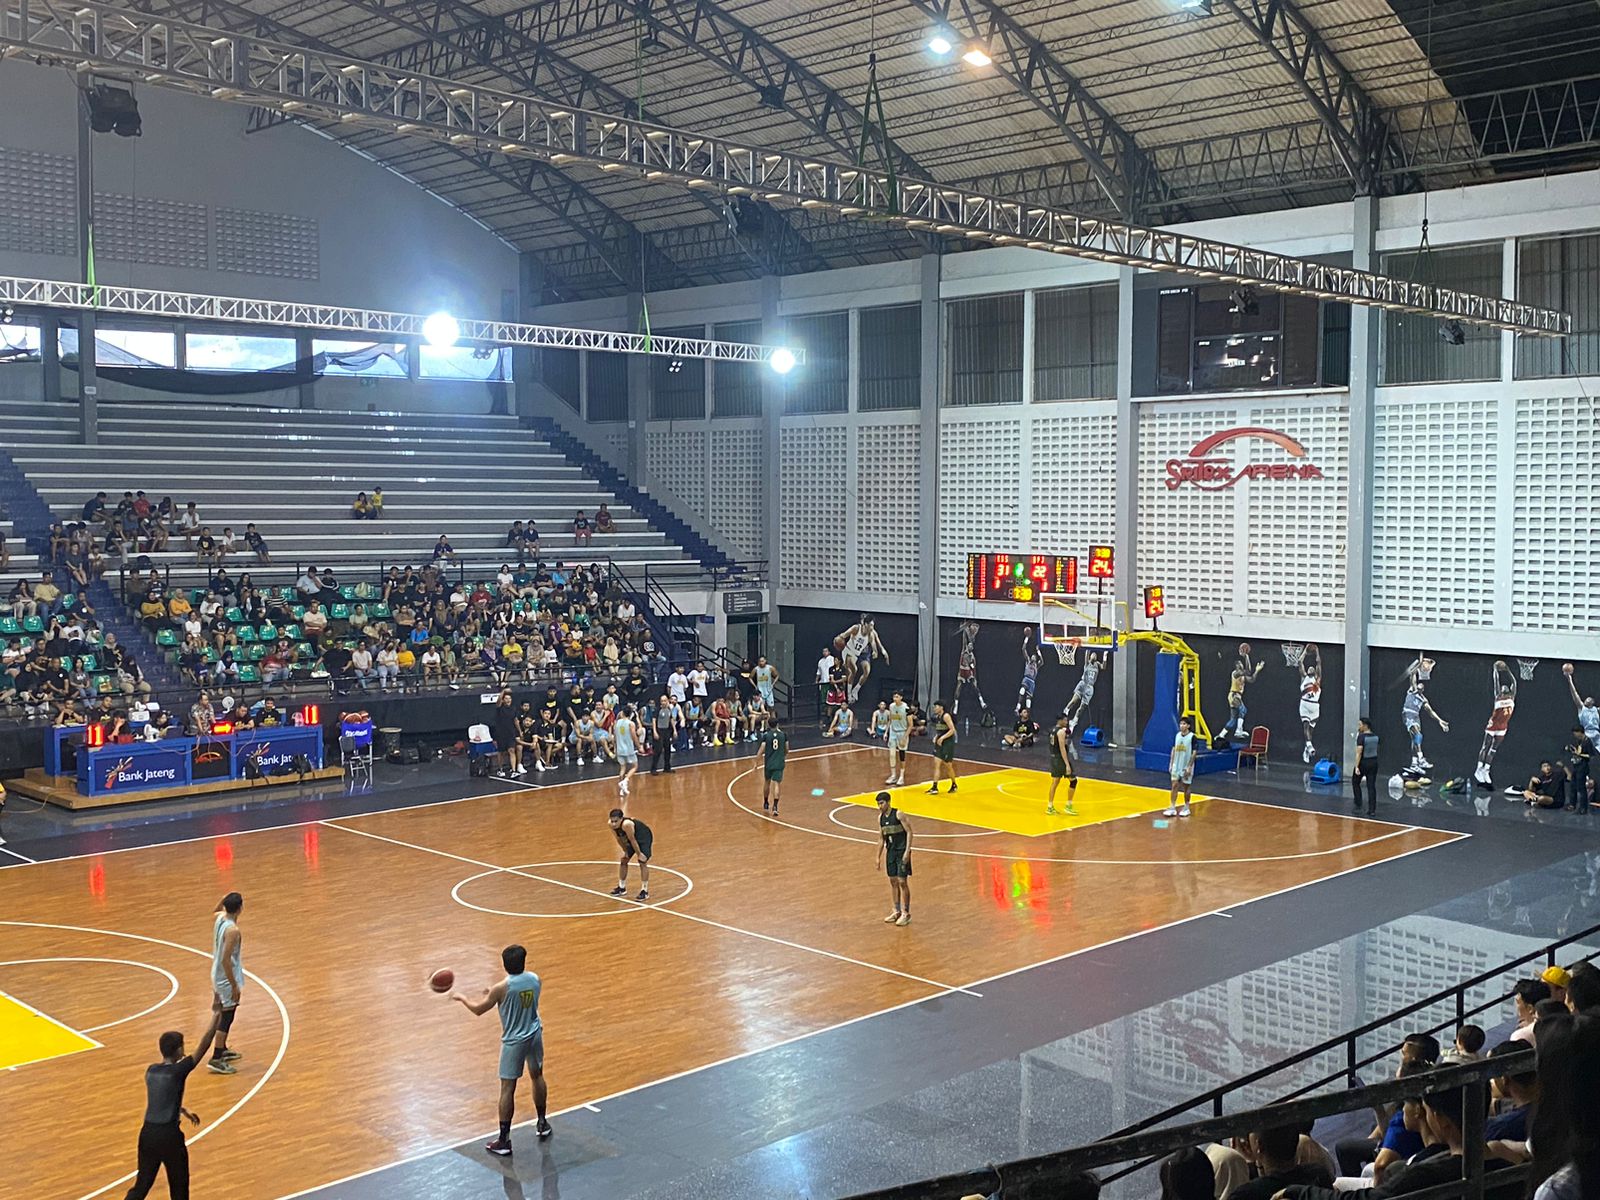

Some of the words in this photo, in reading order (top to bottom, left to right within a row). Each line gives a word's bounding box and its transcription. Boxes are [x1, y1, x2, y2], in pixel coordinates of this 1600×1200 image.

[1239, 464, 1324, 480] ARENA
[997, 563, 1010, 577] 31
[303, 704, 319, 725] 11
[87, 724, 103, 745] 11
[772, 738, 779, 750] 8
[256, 755, 279, 766] Bank
[118, 770, 143, 782] Bank
[144, 768, 175, 782] Jateng
